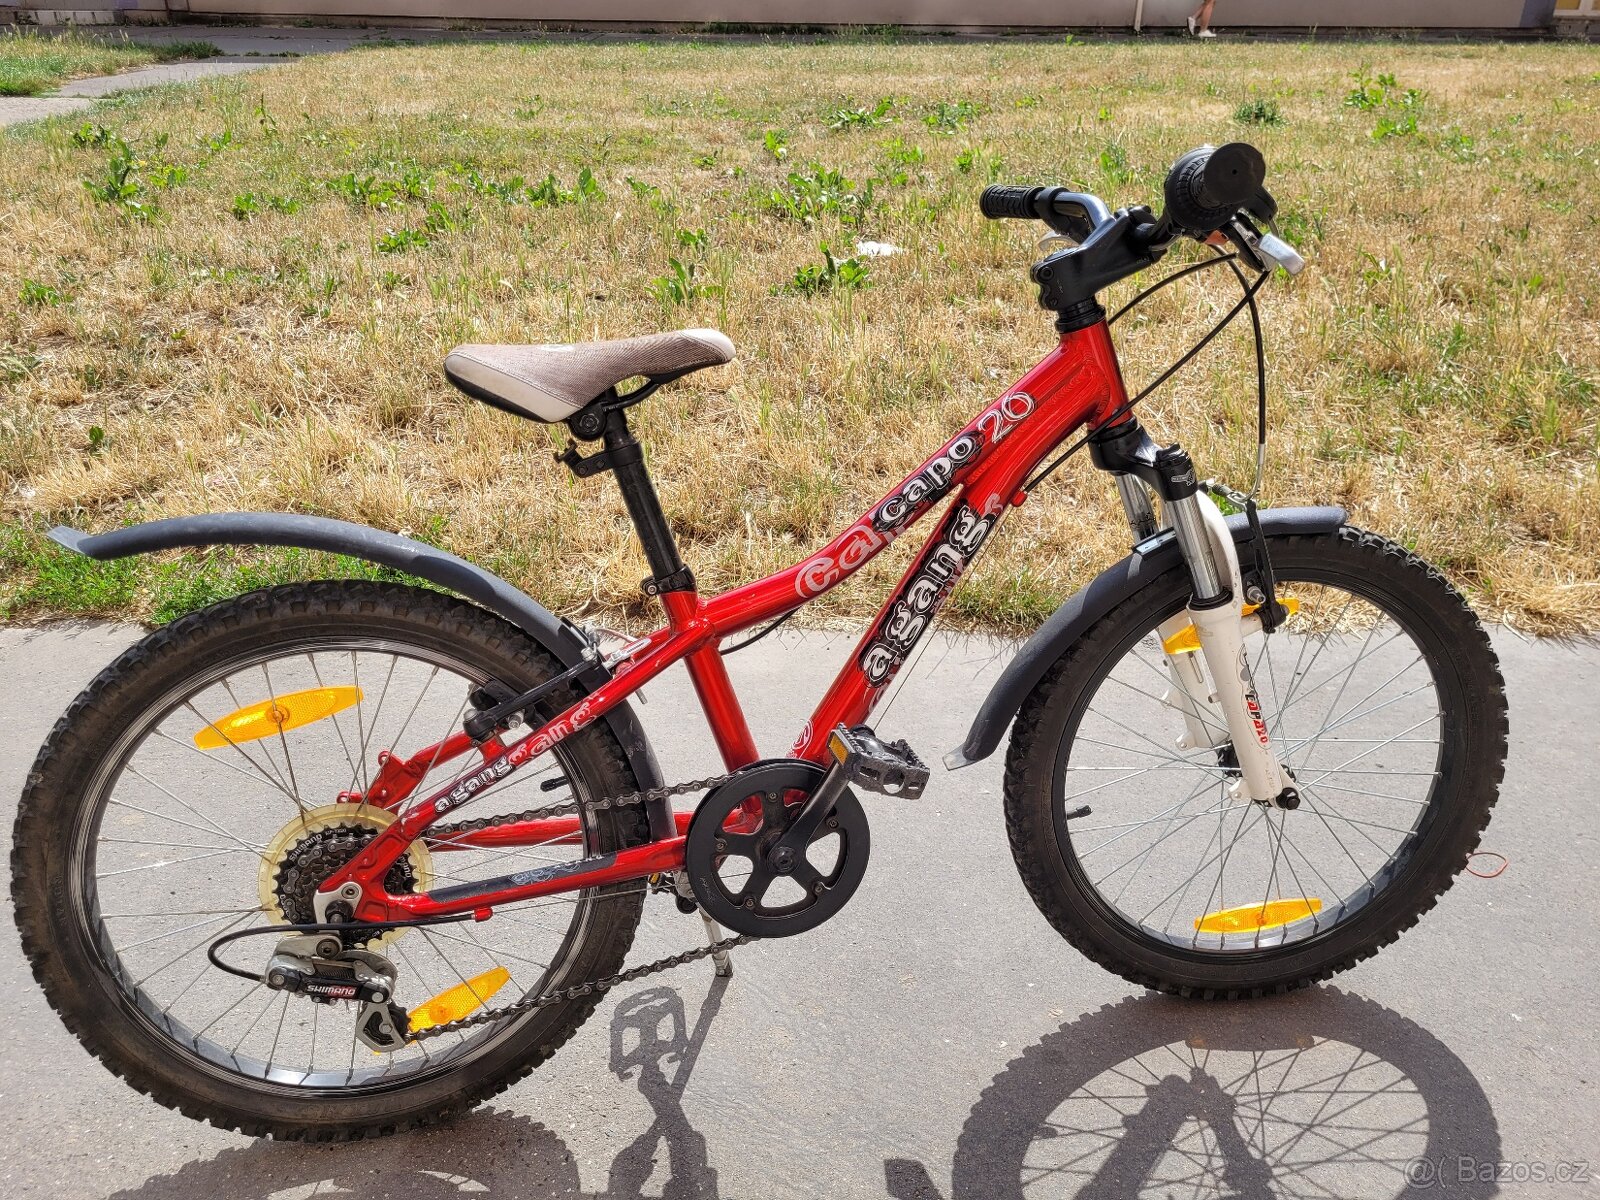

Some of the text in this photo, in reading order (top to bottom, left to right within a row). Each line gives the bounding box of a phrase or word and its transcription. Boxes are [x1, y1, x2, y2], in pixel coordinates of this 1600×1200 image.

[878, 391, 1036, 522] capo 20
[861, 503, 990, 681] agang
[434, 756, 514, 813] agang
[307, 984, 358, 996] SHIMANO
